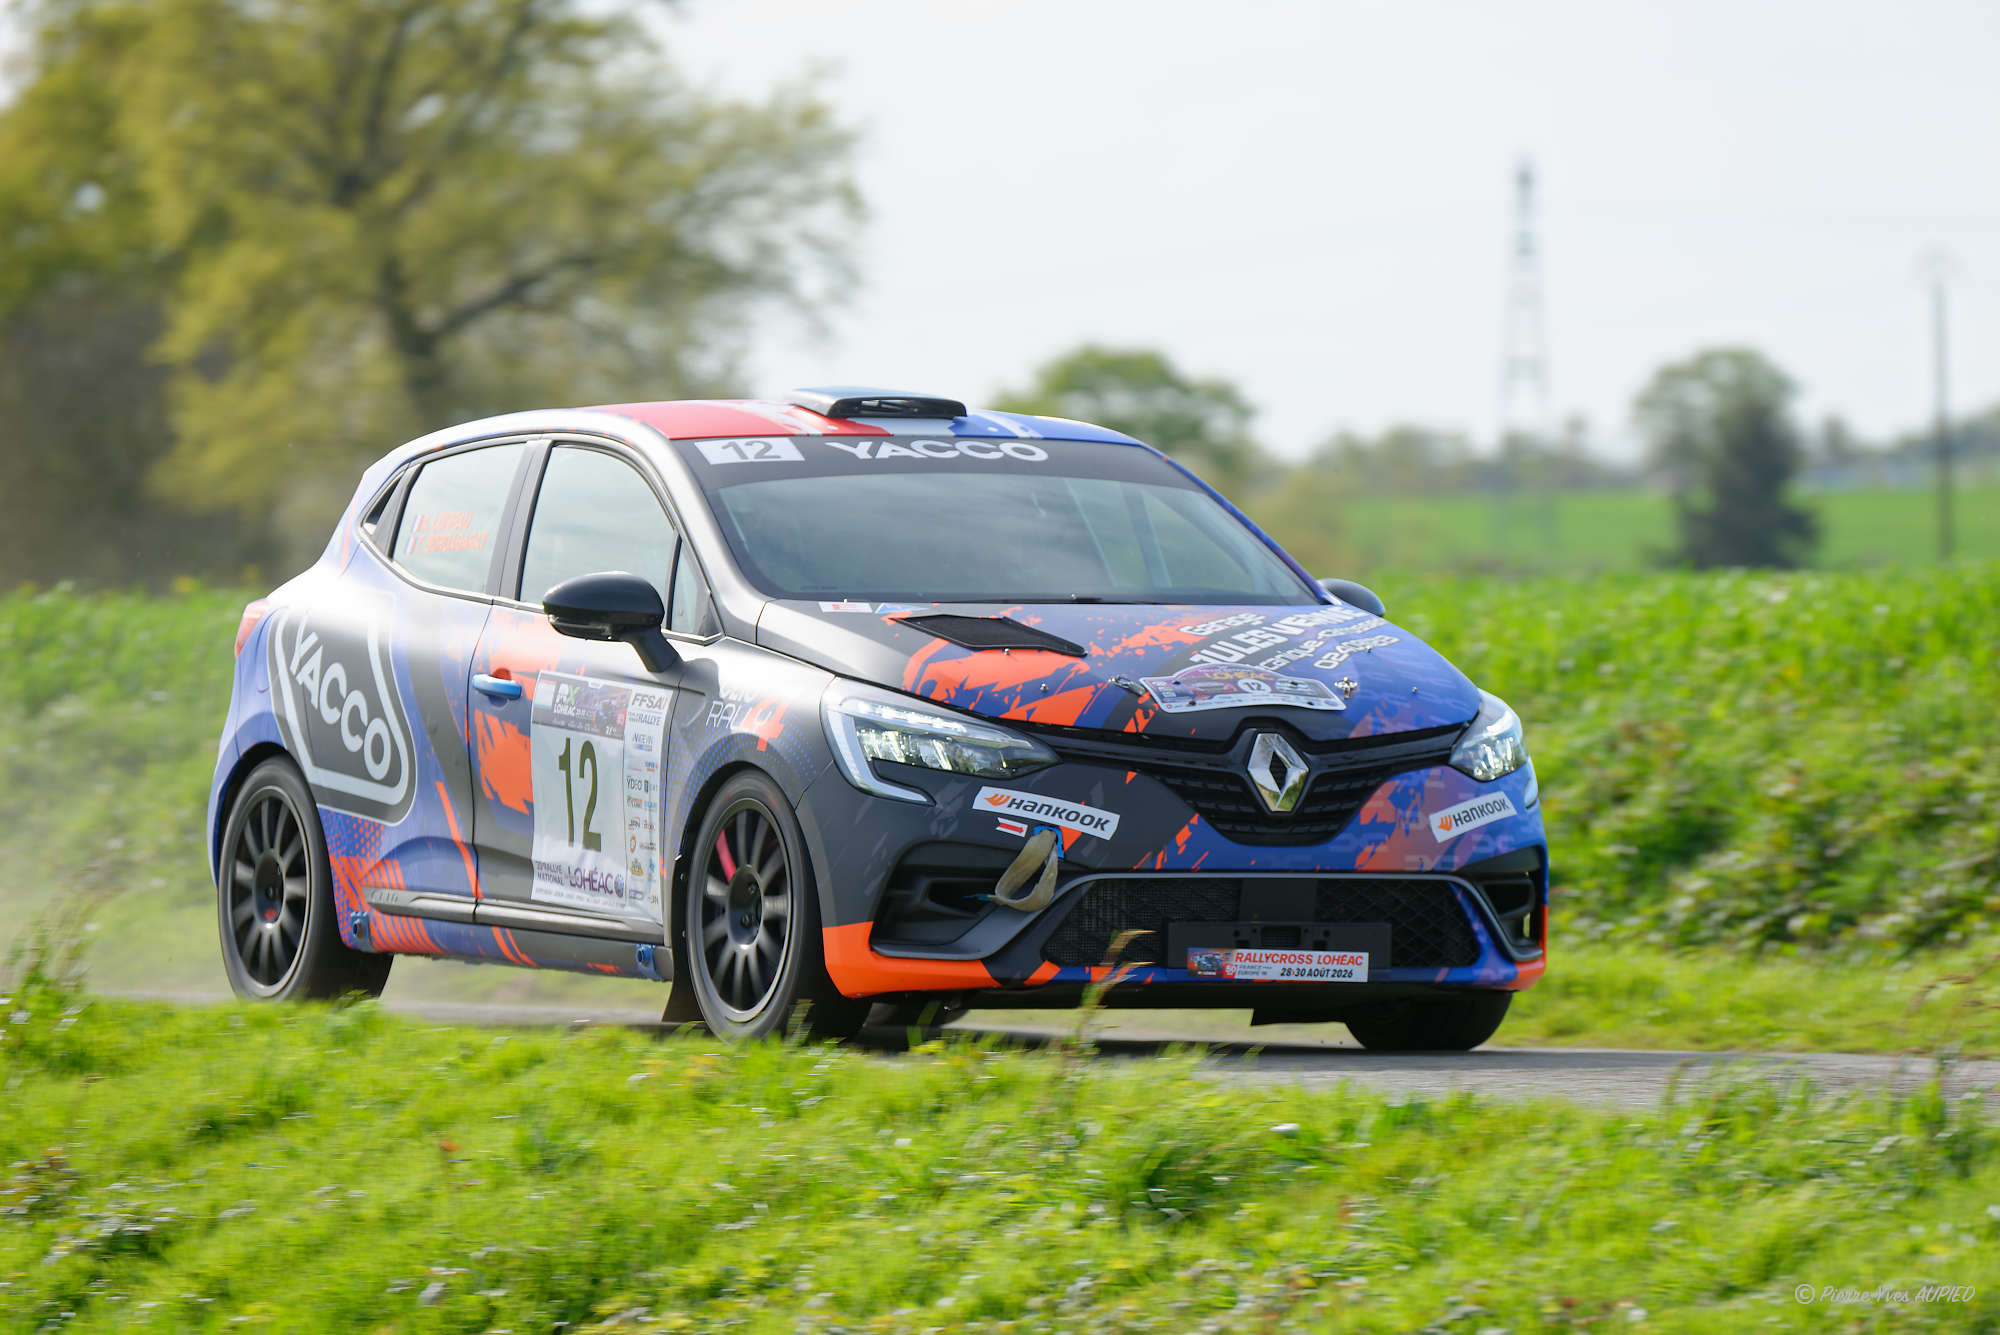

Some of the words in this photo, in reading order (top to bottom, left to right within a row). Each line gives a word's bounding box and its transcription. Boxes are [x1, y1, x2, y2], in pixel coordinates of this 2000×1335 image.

[720, 440, 783, 460] 12
[825, 440, 1049, 461] YACCO
[1189, 629, 1288, 664] JULES
[289, 610, 391, 781] YACCO
[1244, 681, 1262, 692] 12
[631, 693, 663, 710] FFSA
[639, 712, 662, 726] RALLYE
[558, 736, 601, 852] 12
[567, 866, 614, 895] LOHÉAC
[1235, 952, 1313, 965] RALLYCROSS
[1331, 968, 1353, 978] 2026
